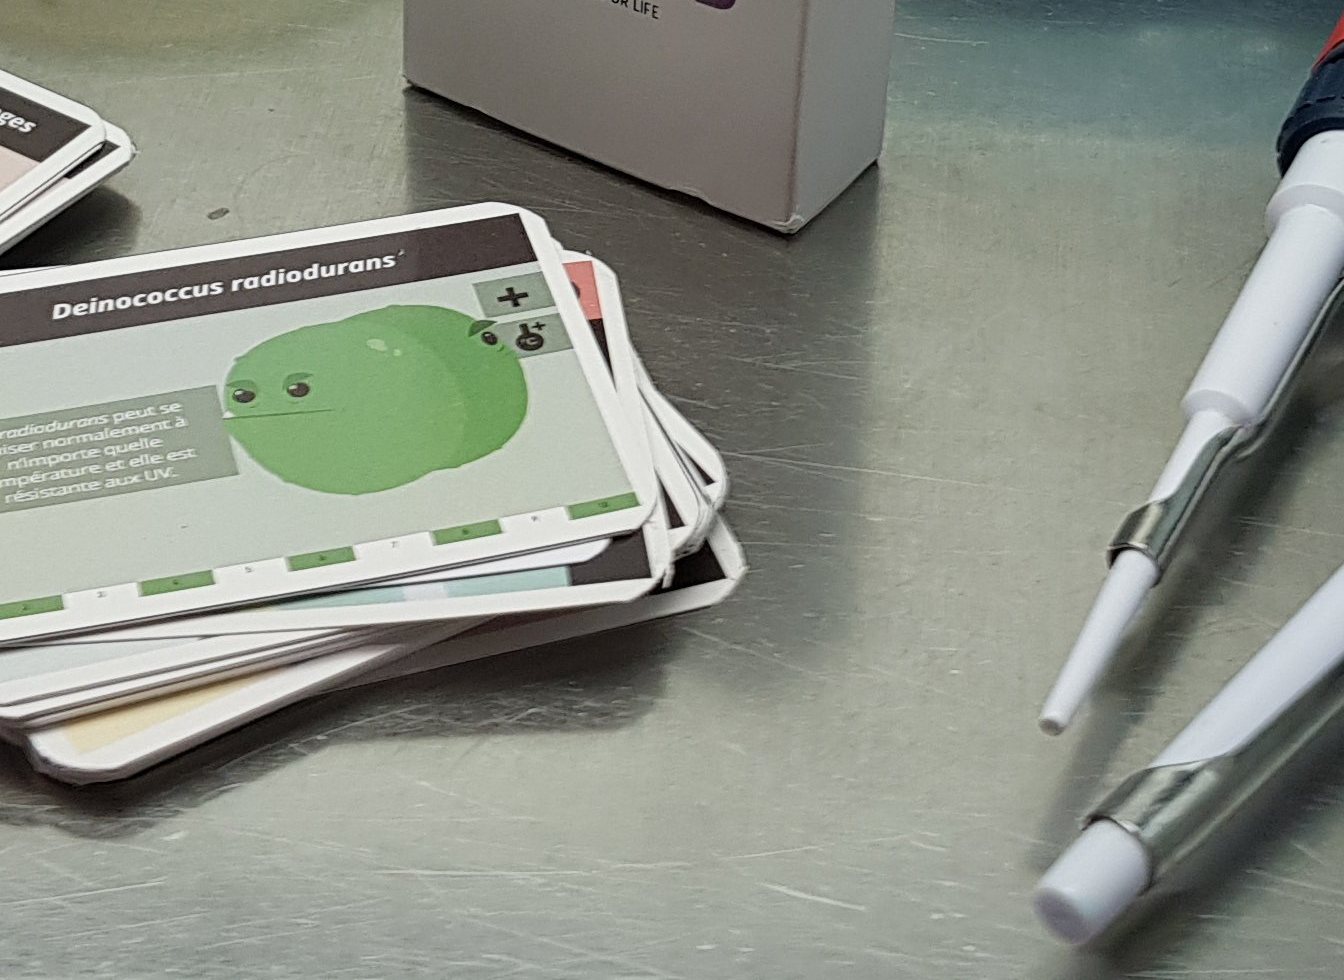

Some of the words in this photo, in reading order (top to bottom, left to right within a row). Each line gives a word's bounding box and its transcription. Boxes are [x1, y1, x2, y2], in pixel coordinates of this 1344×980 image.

[51, 279, 224, 320] Deinococcus
[113, 404, 158, 425] peut
[159, 401, 184, 415] se
[42, 421, 172, 450] normalement
[173, 415, 189, 429] à
[104, 436, 163, 457] quelle
[104, 458, 127, 472] et
[129, 451, 163, 467] elle
[166, 447, 198, 460] est
[4, 478, 102, 504] résistante
[104, 474, 141, 488] aux
